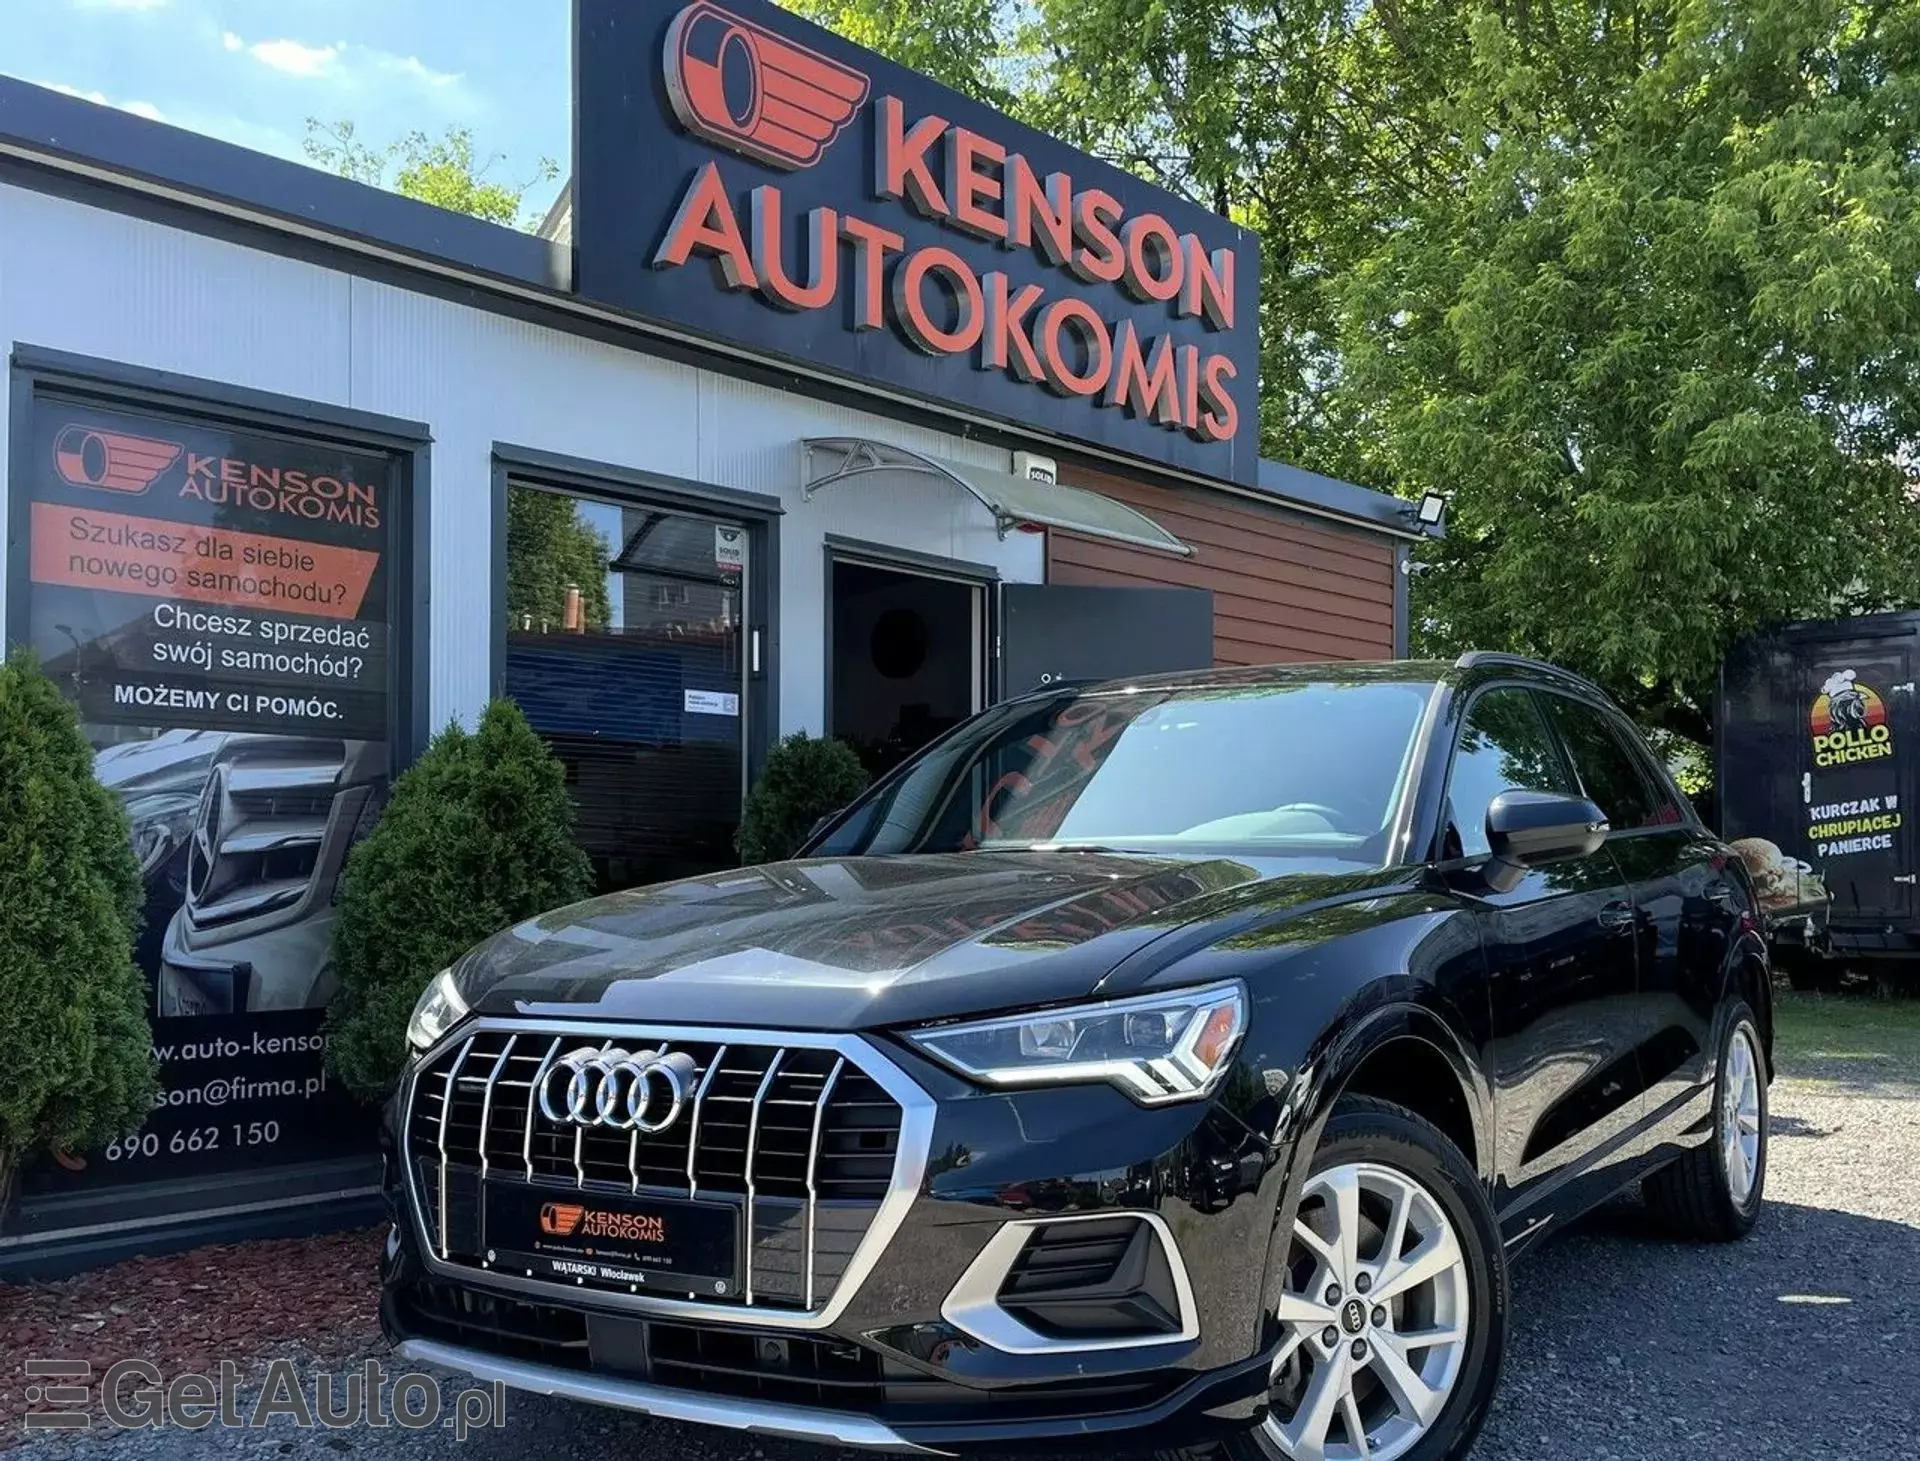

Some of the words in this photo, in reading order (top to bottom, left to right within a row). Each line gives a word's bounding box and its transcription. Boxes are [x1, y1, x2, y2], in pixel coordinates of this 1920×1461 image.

[876, 96, 1235, 330] KENSON
[653, 161, 1239, 442] AUTOKOMIS
[187, 453, 375, 505] KENSON
[179, 476, 380, 529] AUTOKOMIS
[69, 516, 187, 554] Szukasz
[195, 536, 234, 560] dla
[242, 544, 315, 572] siebie
[69, 555, 177, 588] nowego
[187, 568, 347, 605] samochodu?
[154, 604, 252, 636] Chcesz
[260, 620, 370, 649] sprzedać
[152, 641, 213, 670] swój
[220, 650, 363, 679] samochód?
[114, 684, 220, 710] MOŻEMY
[226, 694, 249, 712] CI
[255, 693, 344, 719] POMÓC.
[1813, 725, 1889, 752] POLLO
[1816, 742, 1892, 766] CHICKEN
[1810, 798, 1880, 820] KURCZAK
[1885, 795, 1897, 809] W
[1818, 834, 1892, 857] PANIERCE
[147, 1032, 333, 1060] w.auto-kenso
[145, 1067, 326, 1107] son@firma.pl
[106, 1133, 159, 1161] 690
[169, 1127, 220, 1153] 662
[232, 1120, 280, 1147] 150
[581, 1223, 664, 1242] AUTOKOMIS
[585, 1210, 662, 1229] KENSON
